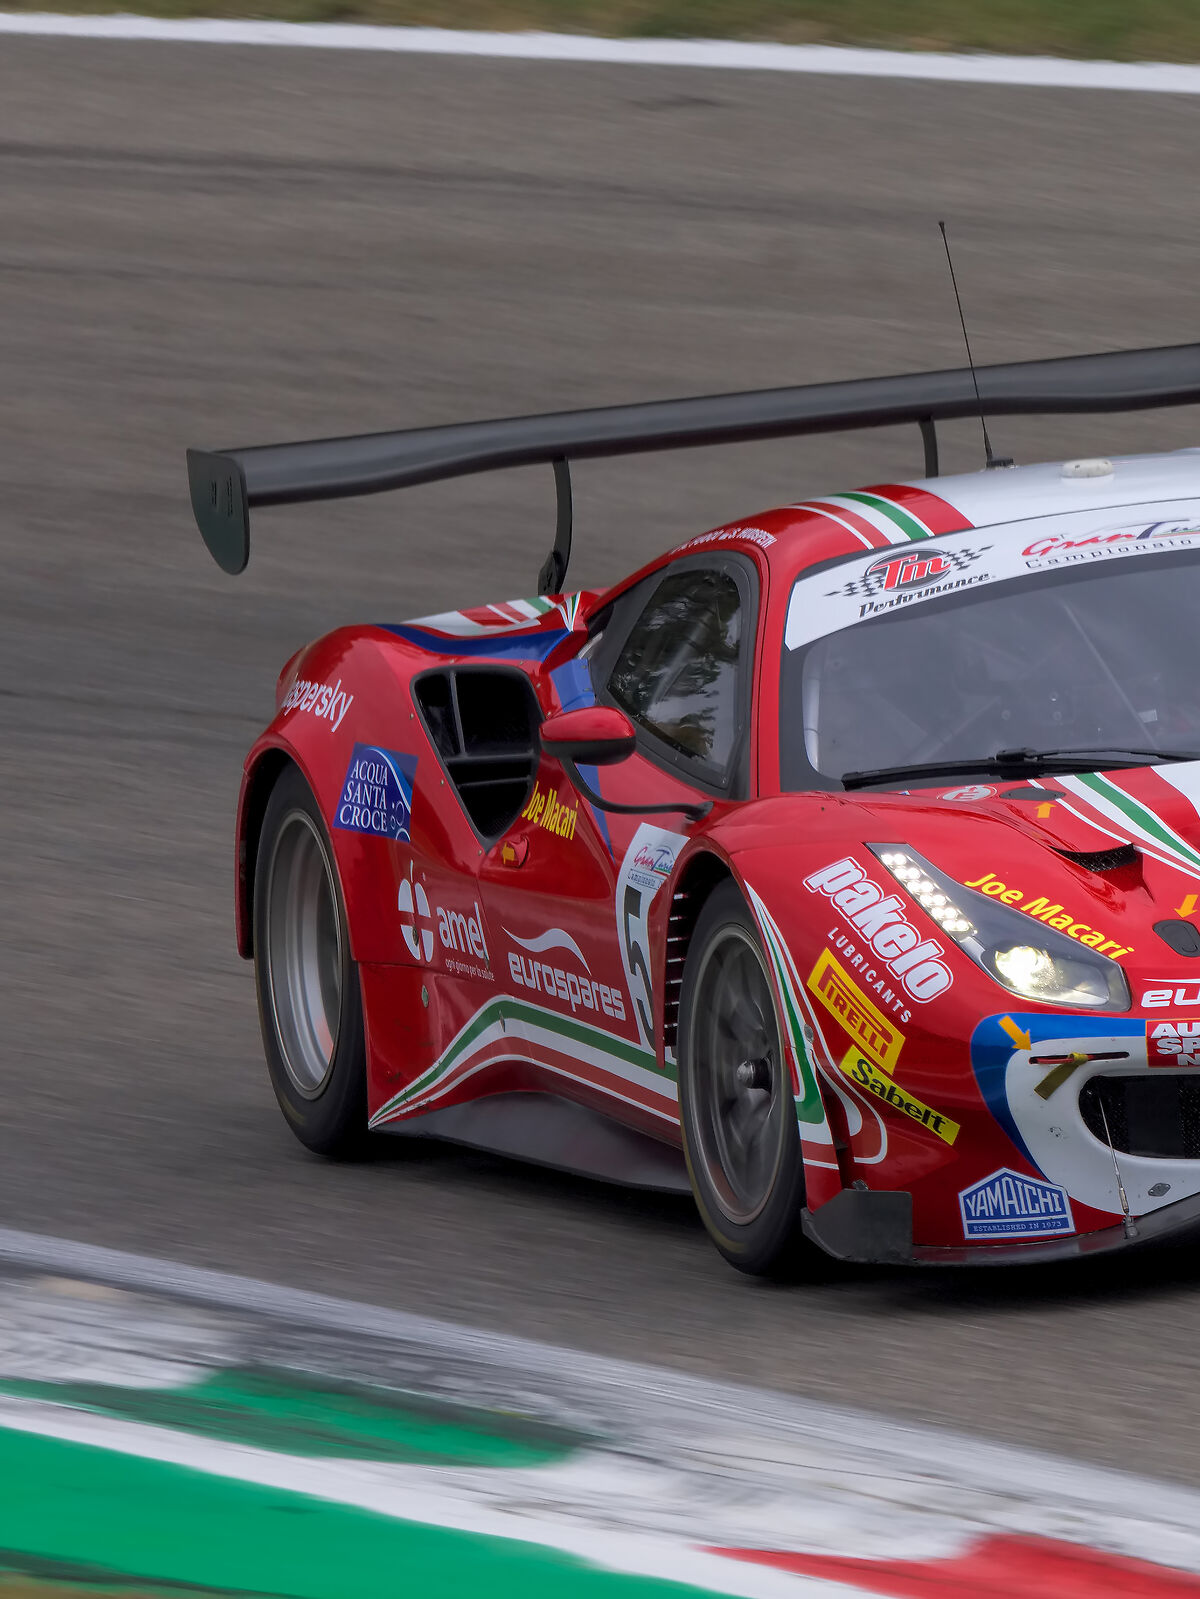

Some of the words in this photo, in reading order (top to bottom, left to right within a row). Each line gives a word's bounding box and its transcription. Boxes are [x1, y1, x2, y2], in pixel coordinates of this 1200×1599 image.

[1025, 538, 1193, 569] Campionato
[858, 573, 992, 618] Performance
[282, 672, 354, 733] spersky
[343, 781, 388, 811] SANTA
[350, 759, 389, 786] ACQUA
[339, 804, 388, 832] CROCE
[521, 780, 546, 824] Joe
[540, 788, 579, 841] Macari
[436, 901, 490, 961] amel
[802, 856, 954, 1004] pakelo
[964, 872, 1024, 904] Joe
[1021, 896, 1135, 960] Macari
[508, 952, 626, 1022] eurospares
[827, 927, 912, 1023] LUBRICANTS
[817, 963, 894, 1059] PIRELLI
[851, 1058, 948, 1135] Sabelt
[965, 1176, 1063, 1217] YAMAICHI
[973, 1223, 1027, 1232] ESTABLISHED
[1029, 1222, 1040, 1230] IN
[1042, 1221, 1062, 1229] 1973
